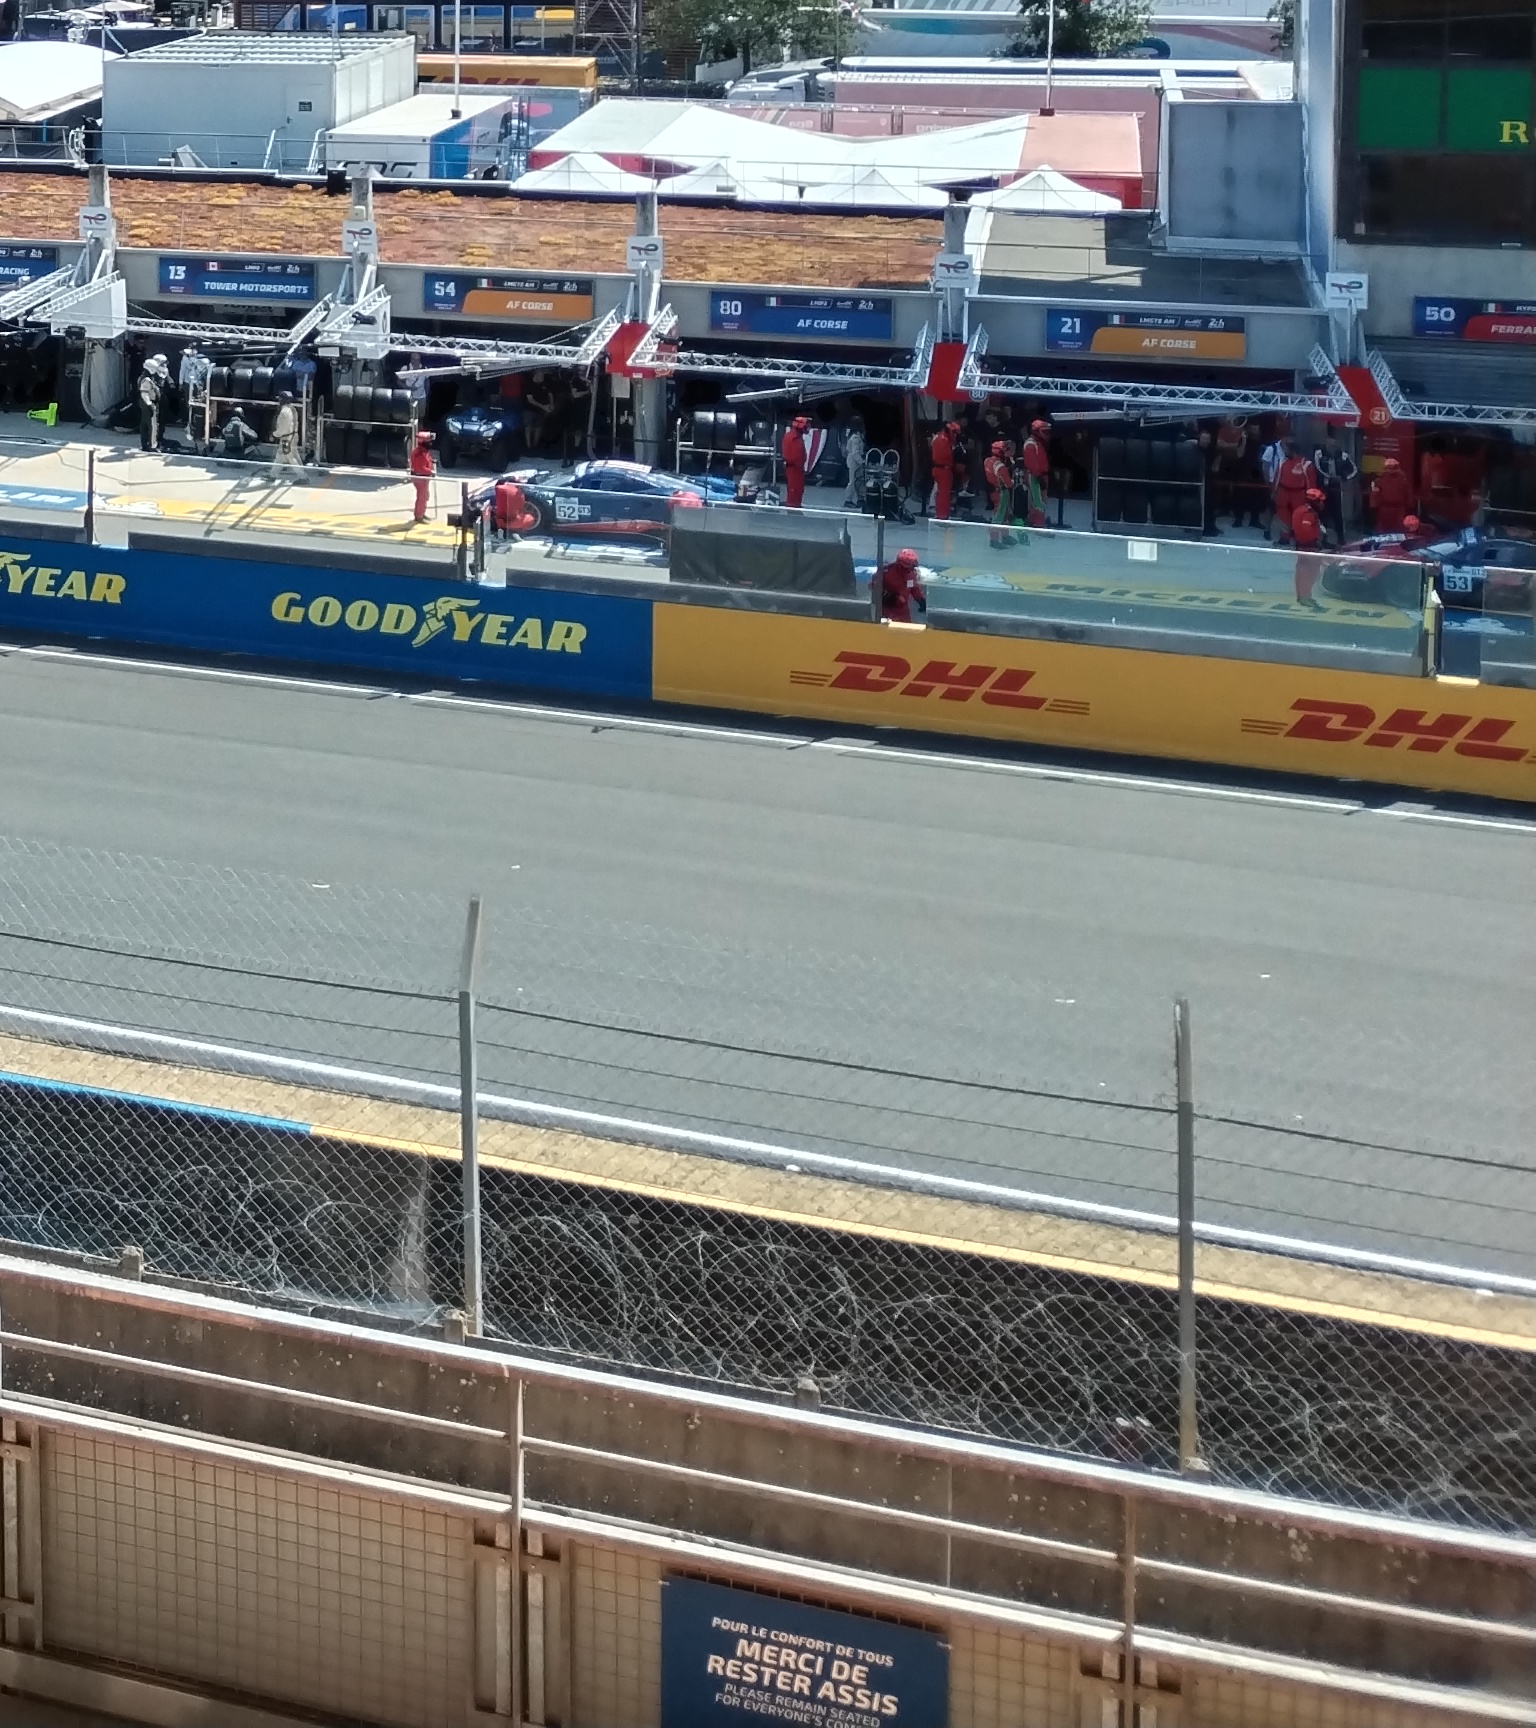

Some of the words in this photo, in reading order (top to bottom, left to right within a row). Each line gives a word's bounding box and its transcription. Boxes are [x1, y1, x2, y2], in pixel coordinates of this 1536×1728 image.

[168, 265, 187, 280] 13
[204, 281, 238, 291] TOWER
[239, 282, 309, 294] MOTORSPORTS
[434, 281, 456, 297] 54
[506, 300, 520, 310] AF
[521, 300, 554, 311] CORSE
[719, 300, 742, 316] 80
[1425, 306, 1456, 322] 50
[797, 319, 813, 328] AF
[814, 319, 848, 330] CORSE
[1061, 317, 1081, 334] 21
[1142, 338, 1158, 348] AF
[1159, 338, 1197, 349] CORSE
[972, 390, 985, 399] 80
[1374, 410, 1386, 421] 21
[558, 505, 578, 520] 52
[1446, 576, 1469, 590] 53
[1044, 582, 1389, 619] MICHELIN
[829, 650, 1049, 711] DHL
[1283, 698, 1532, 762] DHL
[711, 1616, 749, 1635] POUR
[751, 1626, 767, 1640] LE
[770, 1629, 834, 1654] CONFORT
[835, 1643, 854, 1659] DE
[857, 1648, 894, 1667] TOUS
[736, 1638, 825, 1676] MERCI
[831, 1659, 870, 1686] DE
[706, 1653, 812, 1696] RESTER
[817, 1679, 899, 1716] ASSIS
[715, 1692, 741, 1709] FOR
[743, 1700, 824, 1727] EVERYONE'S
[724, 1682, 772, 1704] PLEASE
[775, 1694, 835, 1717] REMAIN
[830, 1707, 881, 1728] SEATED
